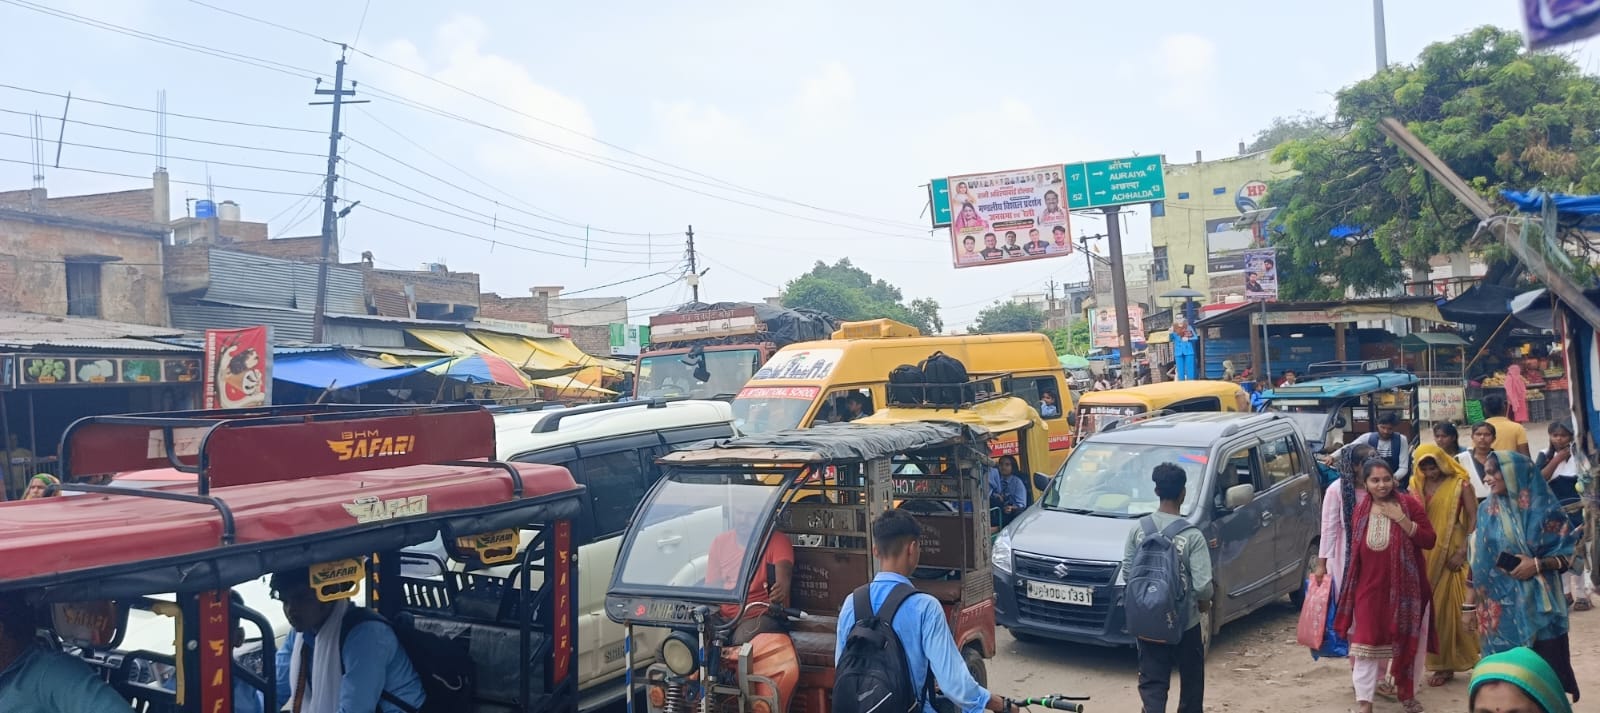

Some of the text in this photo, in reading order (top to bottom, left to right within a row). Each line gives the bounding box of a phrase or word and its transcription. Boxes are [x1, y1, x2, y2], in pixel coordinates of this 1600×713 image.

[1146, 163, 1157, 172] 47
[1071, 173, 1081, 181] 17
[1109, 169, 1147, 182] AURAIYA
[1151, 185, 1161, 193] 13
[1247, 184, 1266, 197] HP
[1072, 193, 1083, 201] 52
[1111, 190, 1154, 202] ACHHALDA
[789, 387, 816, 398] SCHOOL
[341, 430, 380, 441] BHM
[326, 435, 415, 460] SAFARI
[342, 495, 428, 524] SAFARI
[318, 566, 358, 580] SAFARI
[558, 550, 568, 669] SAFARI
